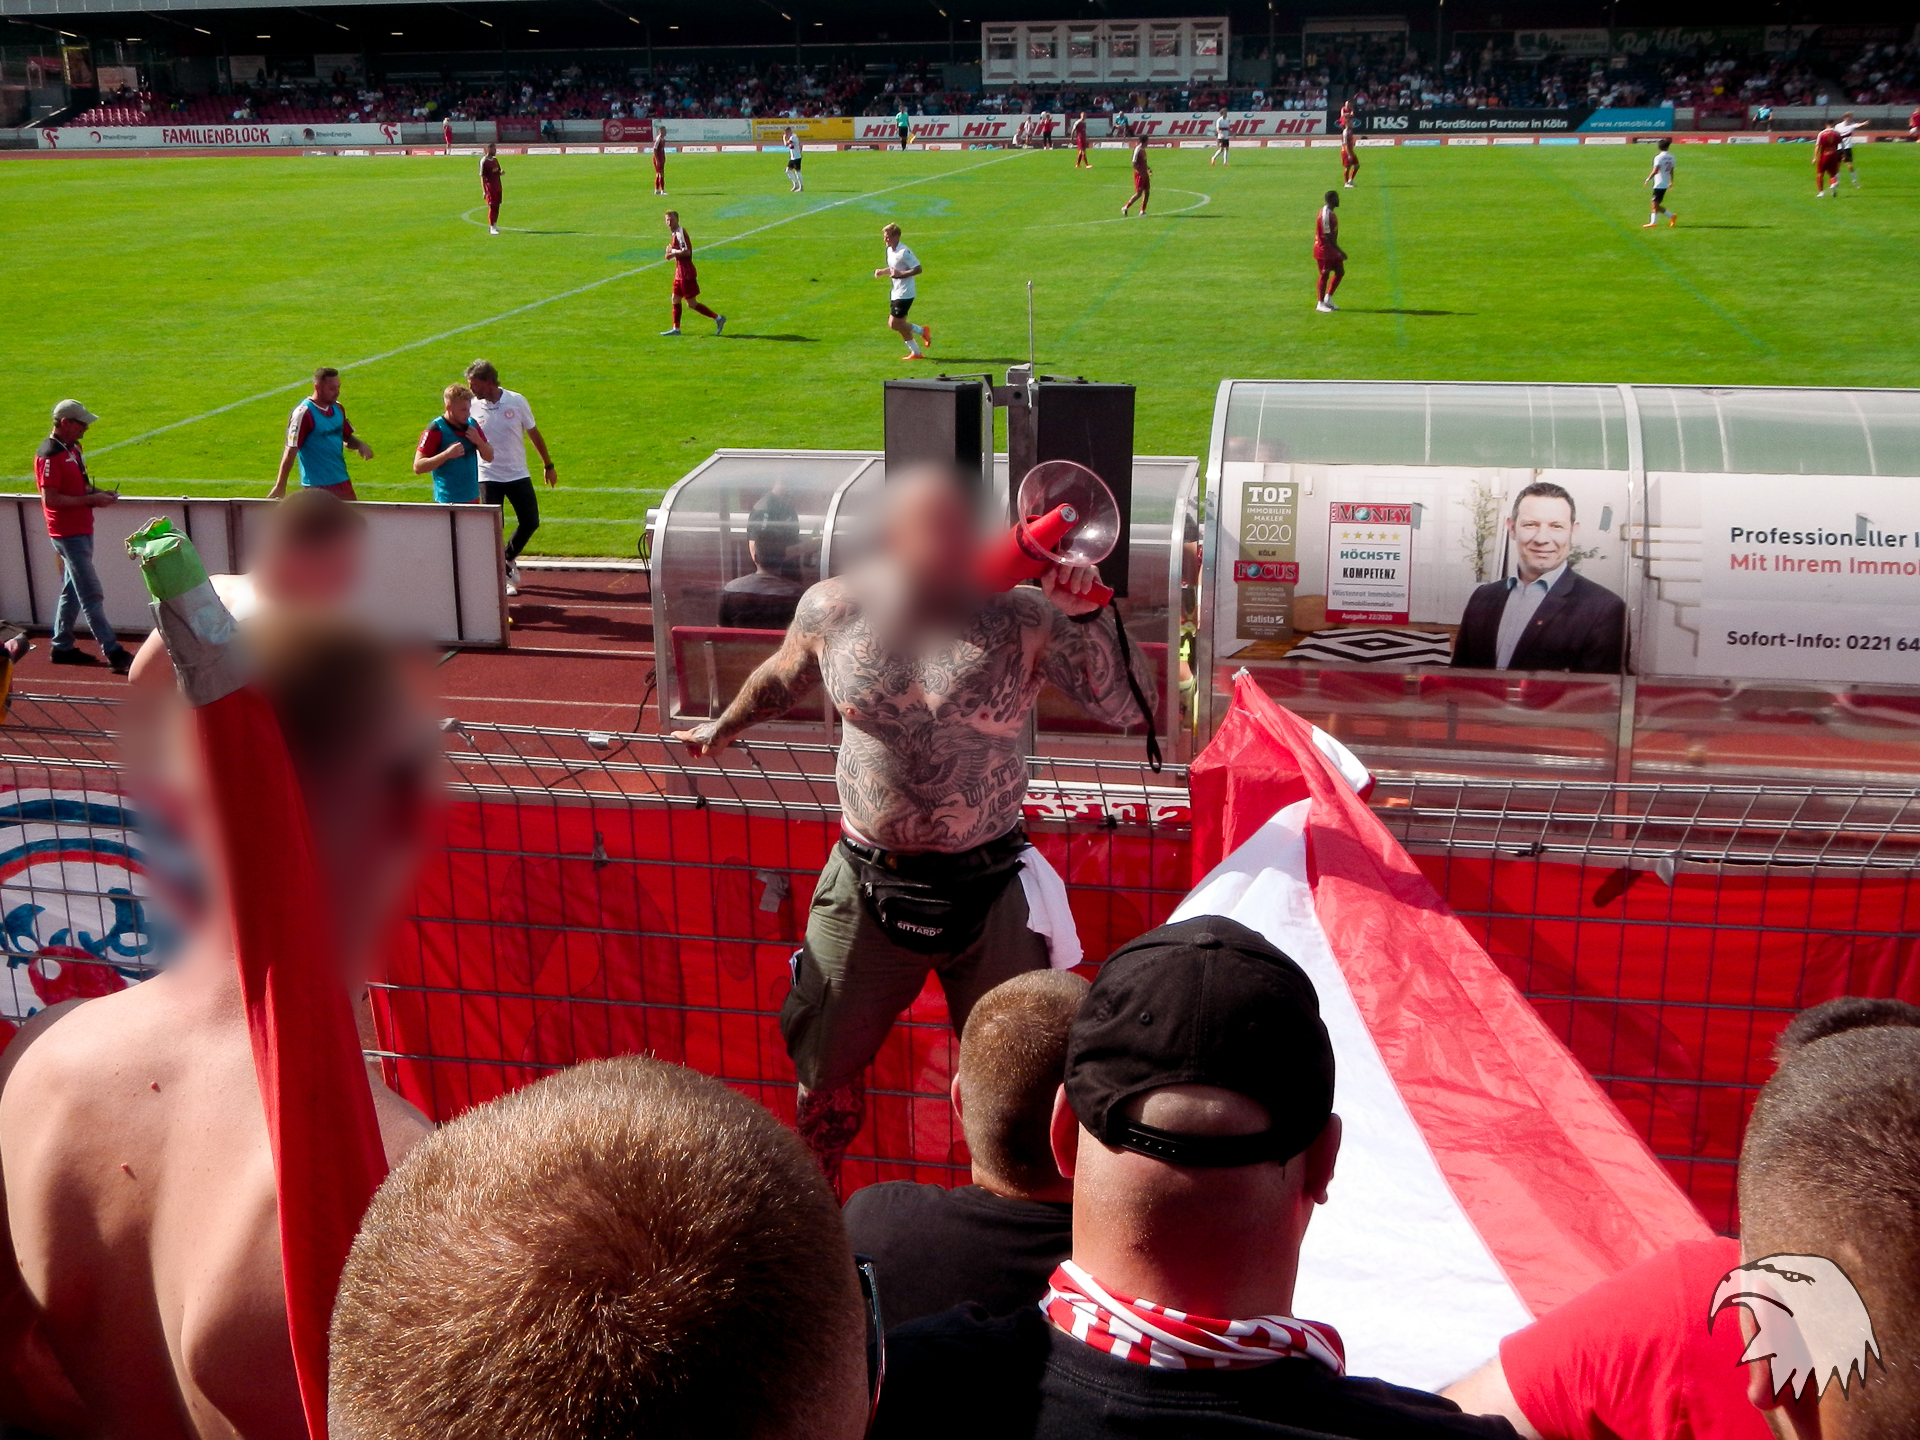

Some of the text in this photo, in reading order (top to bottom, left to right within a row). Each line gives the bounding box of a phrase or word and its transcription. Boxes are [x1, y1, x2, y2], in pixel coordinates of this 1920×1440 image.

[911, 123, 950, 136] HIT
[963, 122, 1007, 136] HIT
[1168, 120, 1213, 134] HIT
[1275, 119, 1321, 133] HIT
[1373, 116, 1409, 129] R&S
[1419, 118, 1568, 129] Ihr FordStore Partner in Köln
[162, 127, 271, 145] FAMILIENBLOCK
[1248, 486, 1293, 503] TOP
[1246, 507, 1292, 515] IMMOBILIEN
[1245, 523, 1292, 542] 2020
[1730, 526, 1908, 548] Professioneller
[1258, 549, 1277, 557] KÖLN
[1340, 549, 1401, 561] HÖCHSTE
[1730, 553, 1768, 571] Mit
[1774, 555, 1842, 574] Ihrem
[1237, 563, 1297, 580] FOCUS
[1342, 567, 1396, 580] KOMPETENZ
[1246, 614, 1275, 624] statista
[1727, 630, 1841, 650] Sofort-Info:
[1846, 635, 1891, 651] 0221
[896, 921, 937, 937] SITTARD
